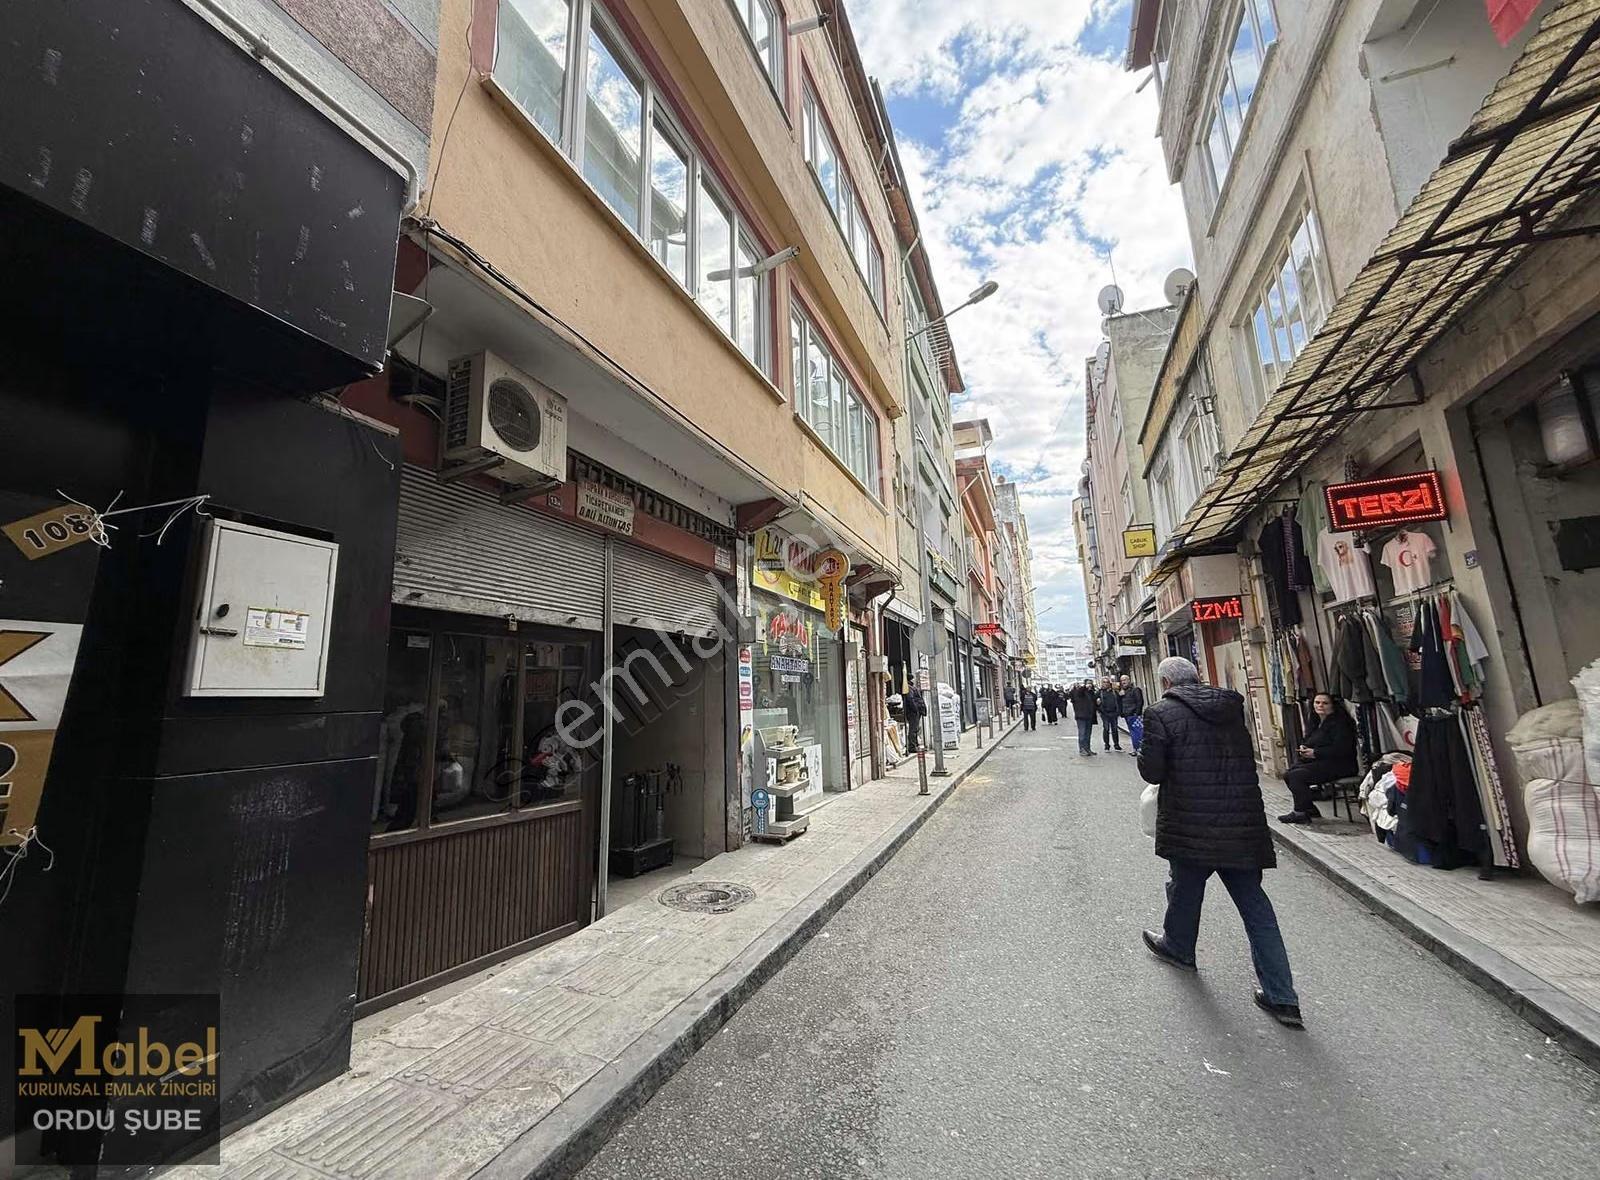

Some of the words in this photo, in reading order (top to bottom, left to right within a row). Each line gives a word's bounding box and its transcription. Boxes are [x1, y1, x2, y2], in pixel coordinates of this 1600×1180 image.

[1337, 482, 1433, 518] TERZİ
[24, 513, 90, 549] 108
[1192, 597, 1243, 621] İZMİ
